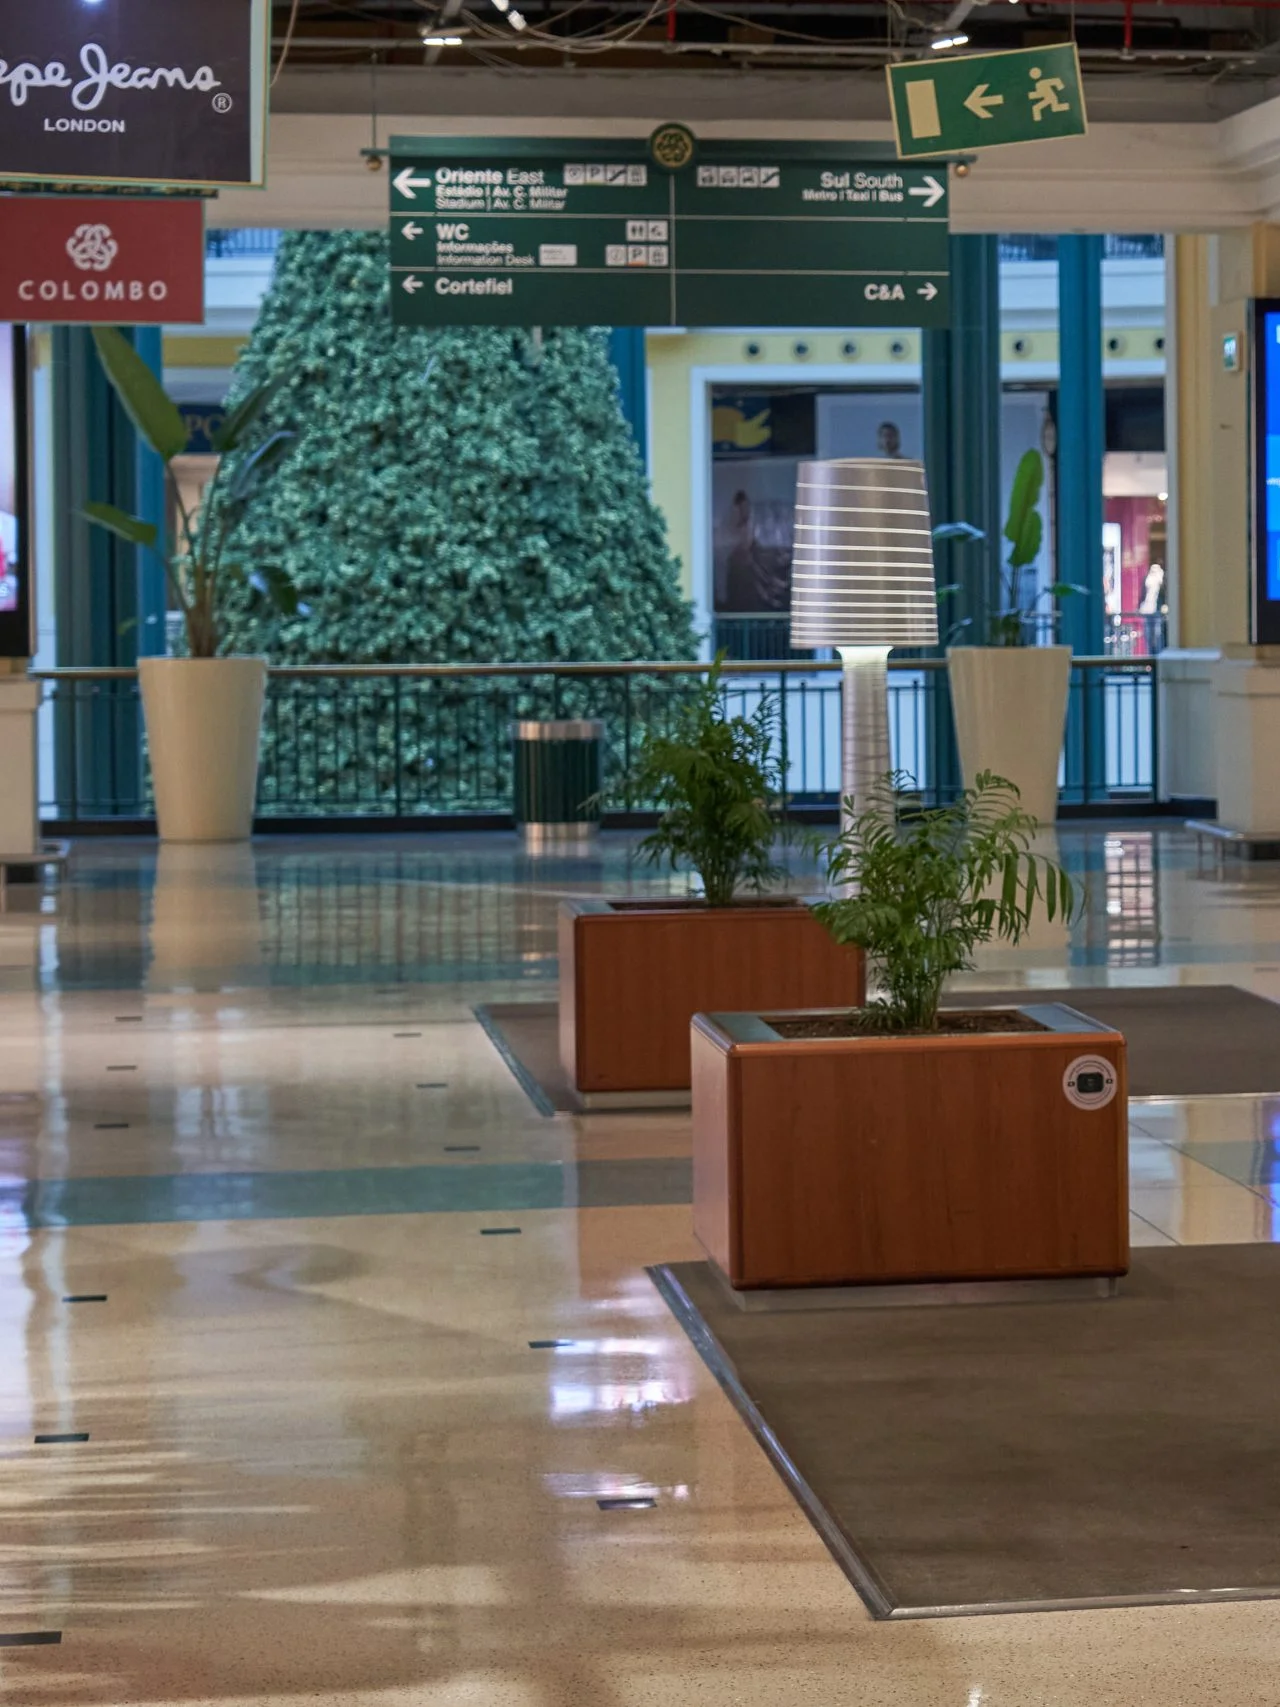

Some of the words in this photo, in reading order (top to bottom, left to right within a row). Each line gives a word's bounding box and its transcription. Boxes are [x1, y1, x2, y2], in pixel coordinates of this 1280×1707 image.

[72, 43, 221, 111] Jeans
[44, 118, 125, 133] LONDON
[436, 167, 502, 184] Oriente
[506, 168, 544, 184] East
[821, 172, 850, 188] Sul
[854, 172, 903, 189] South
[436, 186, 484, 198] Estádio
[513, 187, 527, 198] C.
[803, 190, 837, 201] Metro
[846, 190, 870, 201] Taxi
[879, 190, 903, 202] Bus
[436, 198, 484, 210] Stadium
[513, 198, 527, 210] C.
[436, 224, 470, 240] WC
[436, 241, 513, 256] Informações
[436, 254, 502, 266] Information
[506, 254, 535, 266] Desk
[18, 280, 167, 301] COLOMBO
[435, 278, 513, 294] Cortefiel
[864, 284, 904, 300] C&A
